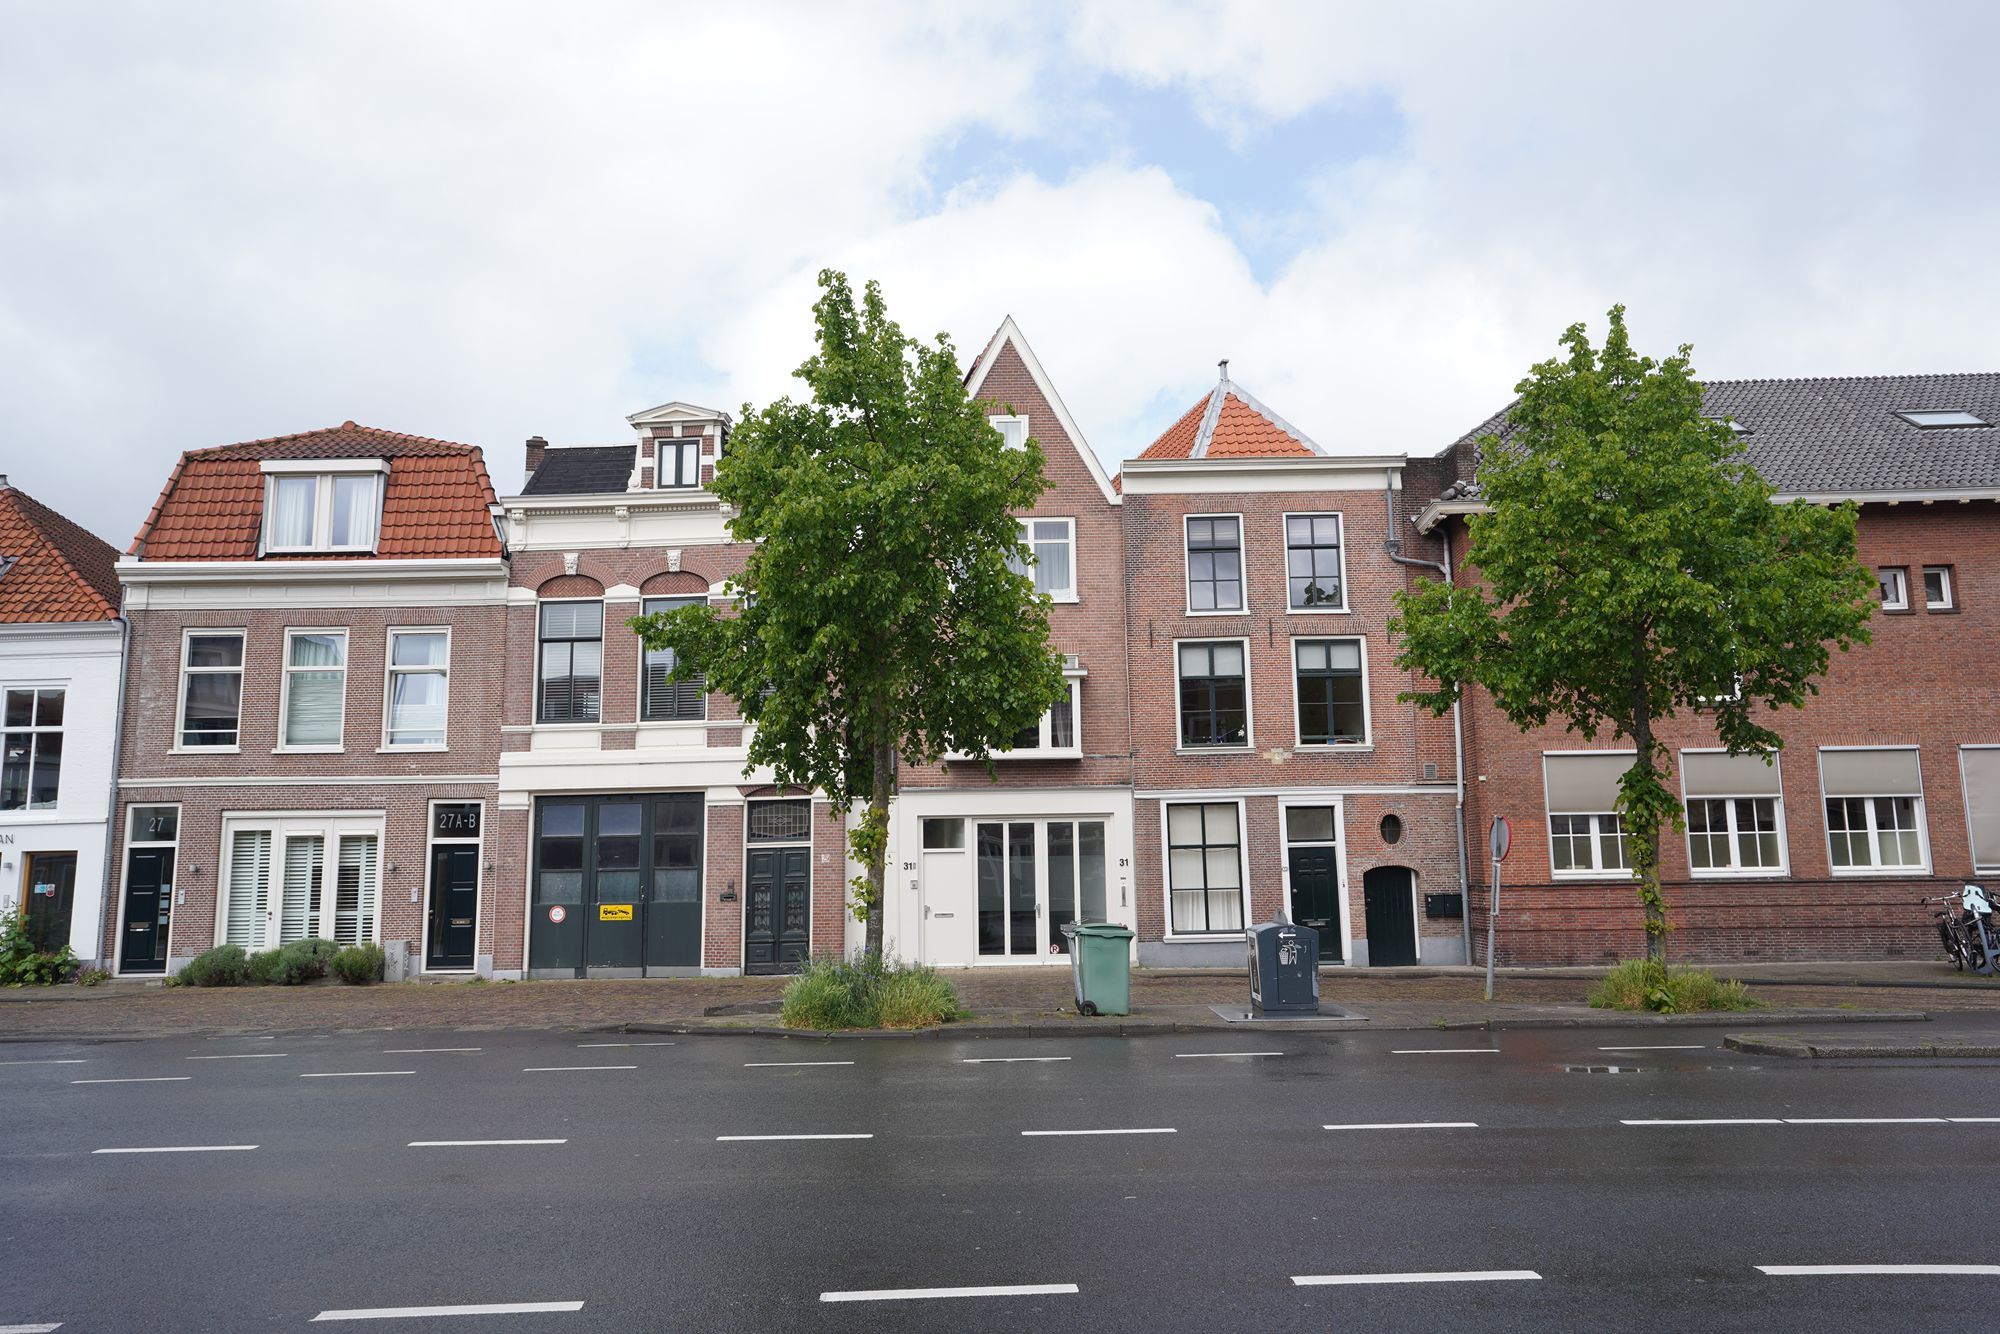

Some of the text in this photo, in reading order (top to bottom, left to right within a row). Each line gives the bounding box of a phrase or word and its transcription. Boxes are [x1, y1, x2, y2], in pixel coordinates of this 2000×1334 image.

[149, 817, 164, 832] 27
[440, 813, 476, 828] 27A-B
[1119, 858, 1128, 866] 31
